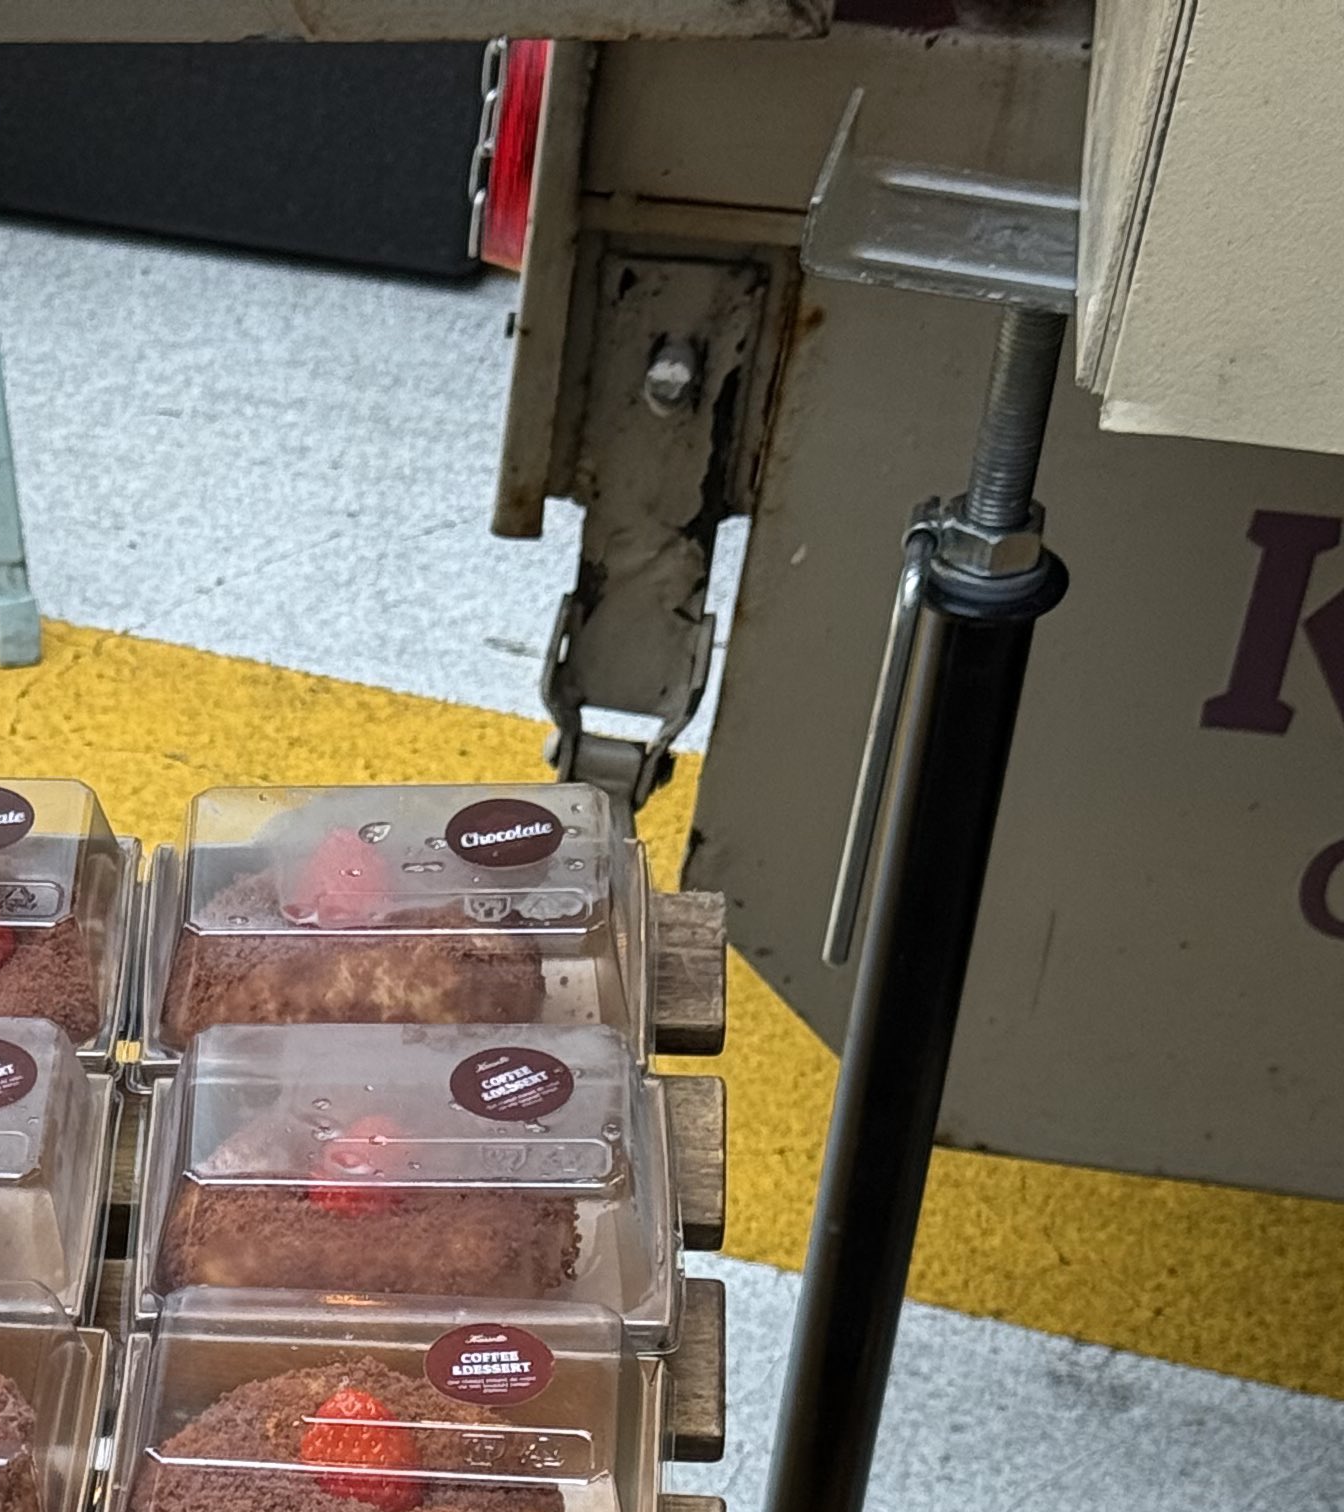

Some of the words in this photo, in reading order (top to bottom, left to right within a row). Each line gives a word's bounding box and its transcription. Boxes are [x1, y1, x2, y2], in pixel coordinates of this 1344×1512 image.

[461, 822, 553, 848] Chocolate
[461, 1351, 519, 1363] COFFEE
[452, 1362, 531, 1375] &DESSERT
